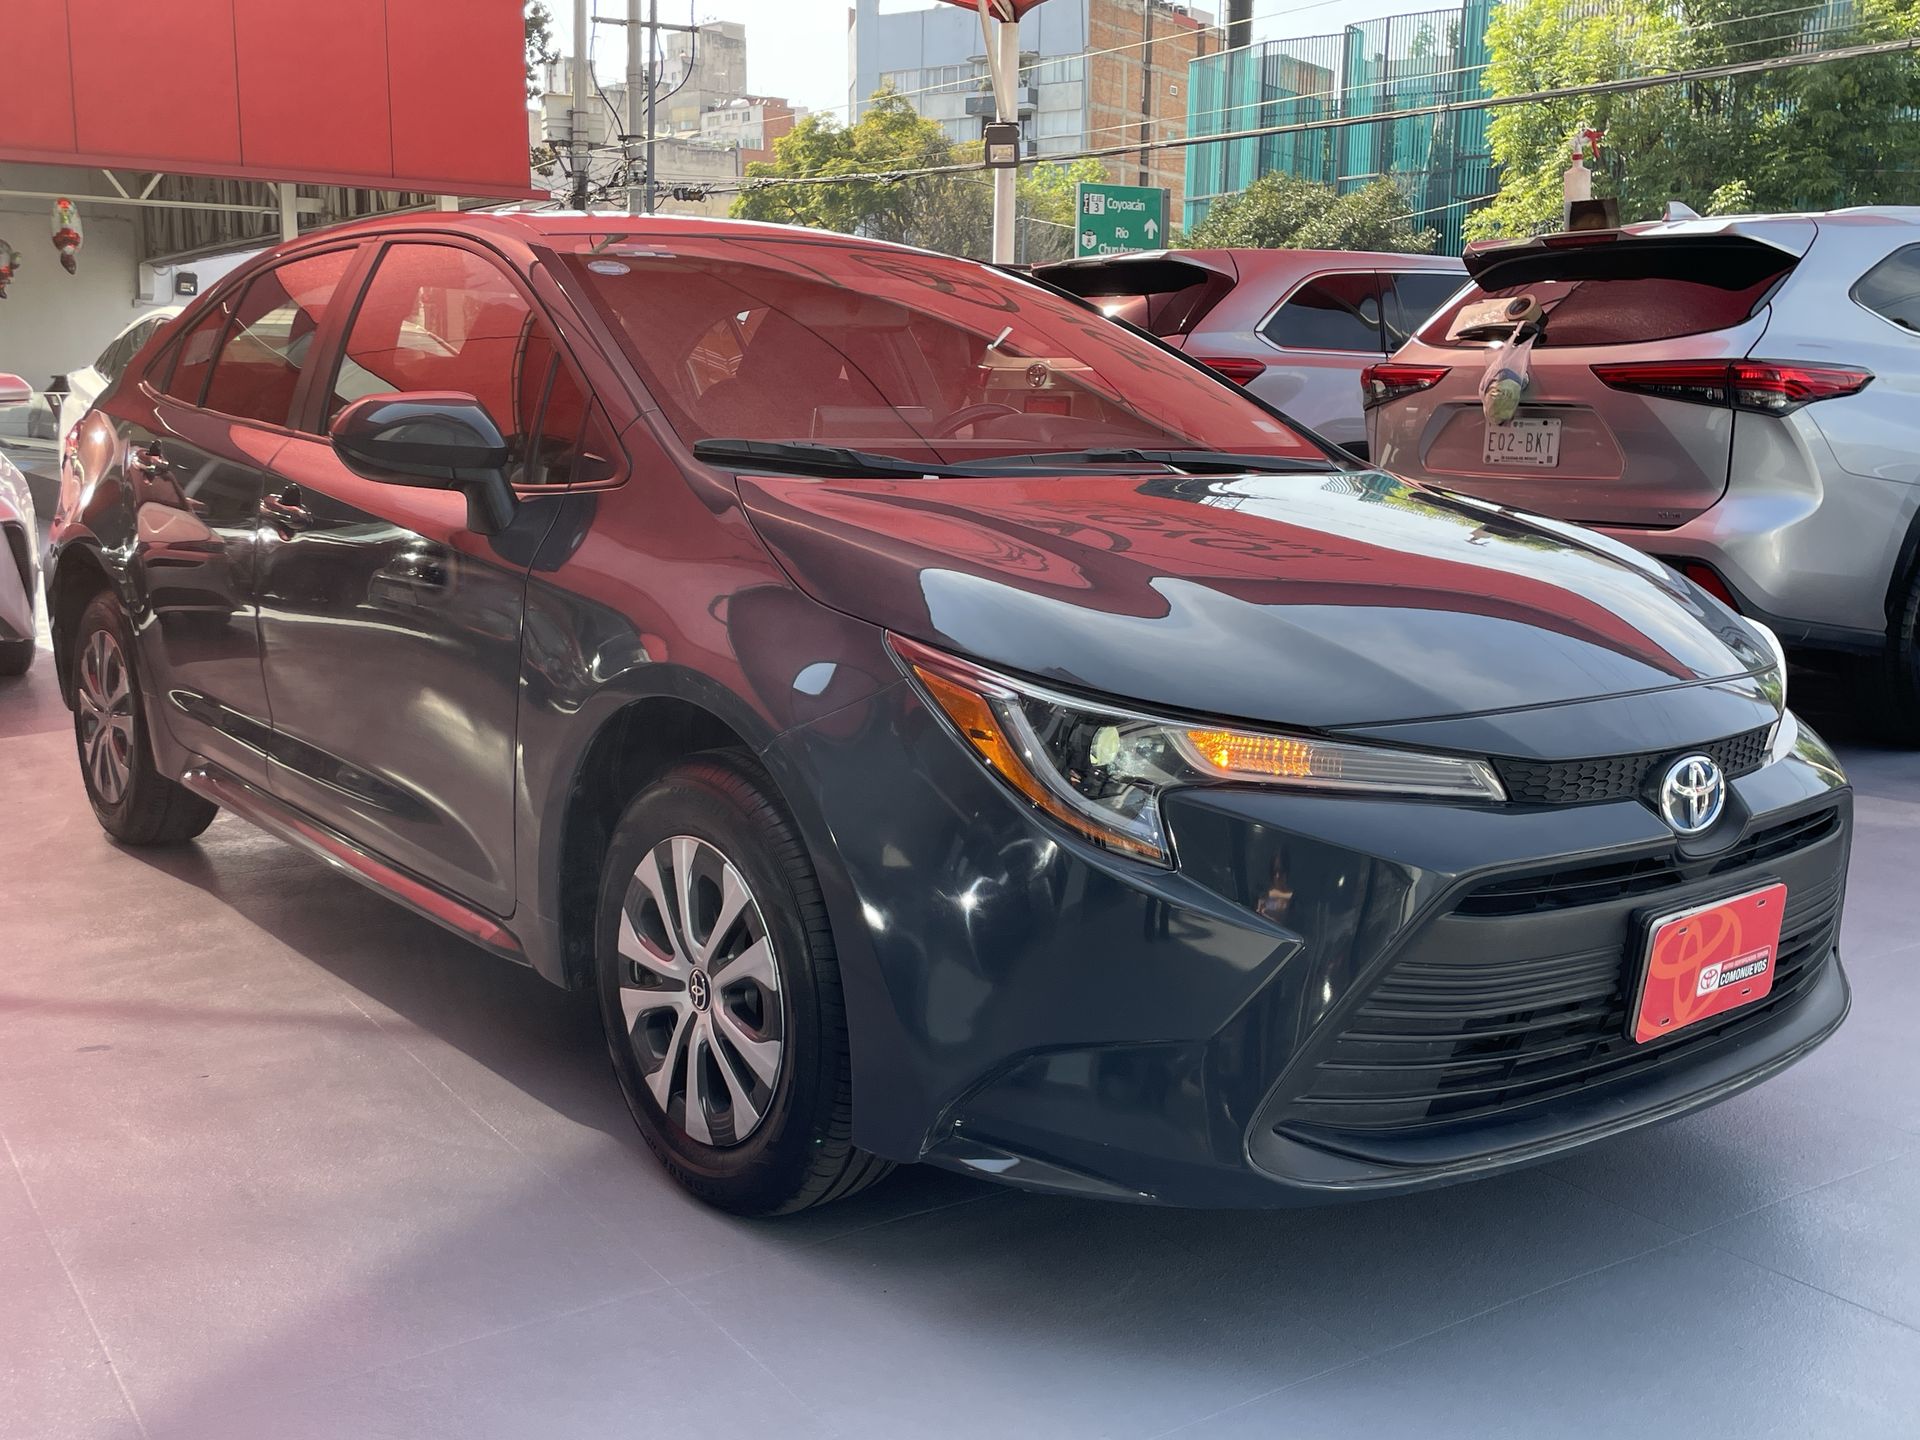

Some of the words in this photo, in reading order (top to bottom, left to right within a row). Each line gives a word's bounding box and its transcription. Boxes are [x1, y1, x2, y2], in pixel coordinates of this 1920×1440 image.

[1093, 203, 1100, 213] 3
[1488, 431, 1554, 454] E02-BKT
[1719, 958, 1768, 986] COMONUEVOS
